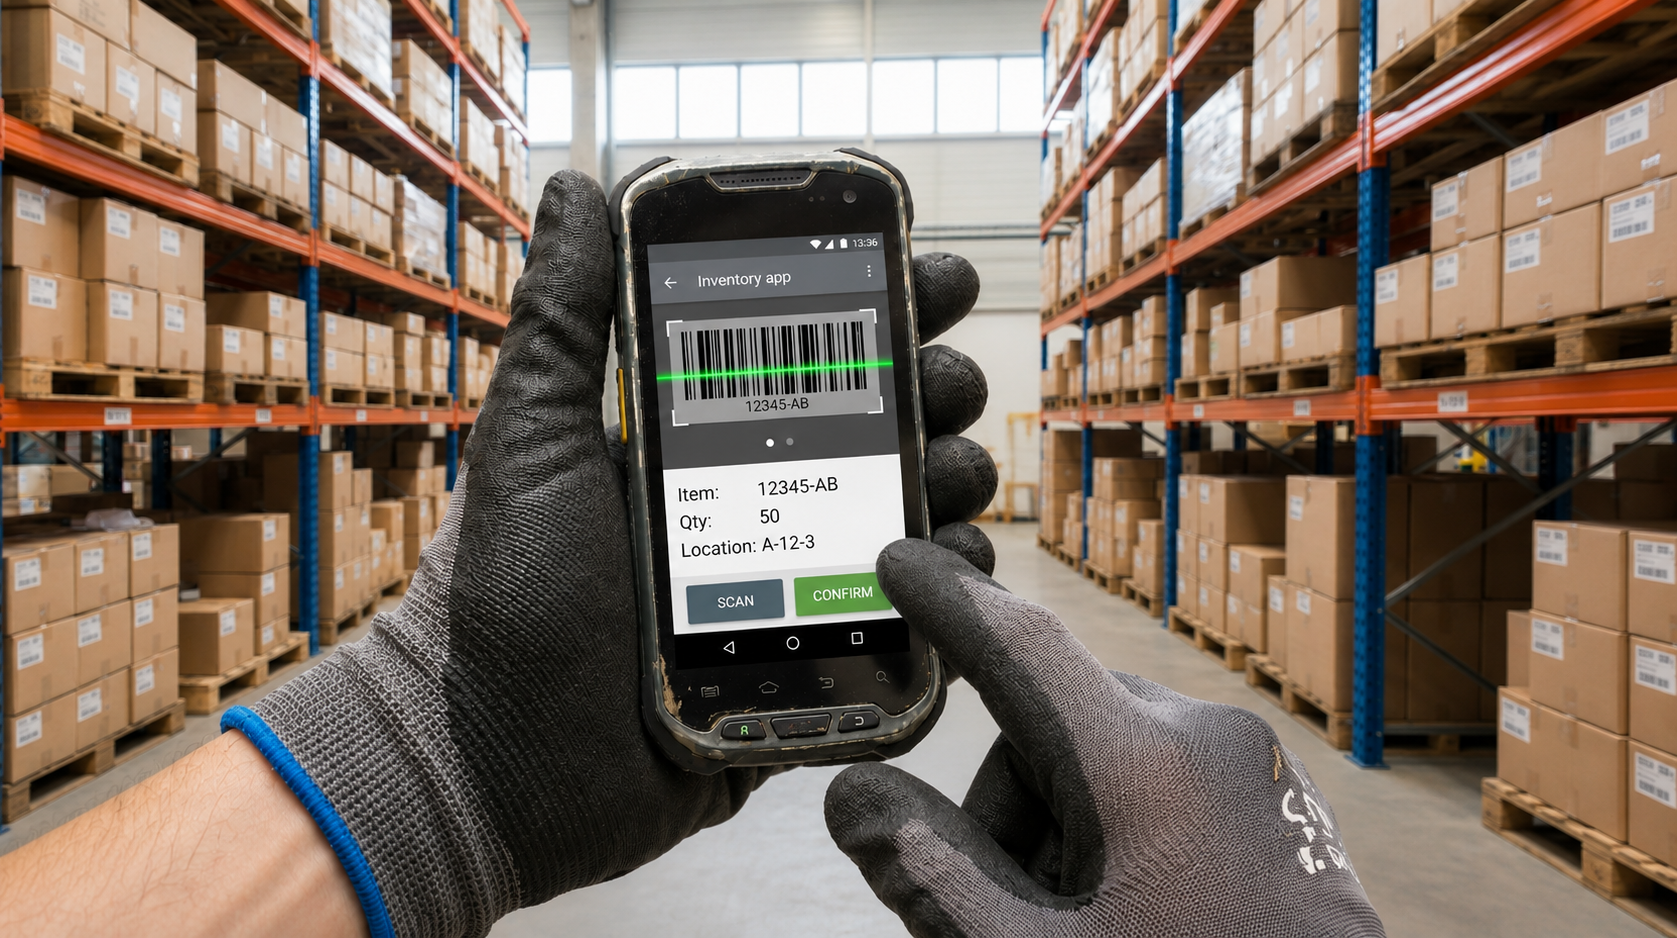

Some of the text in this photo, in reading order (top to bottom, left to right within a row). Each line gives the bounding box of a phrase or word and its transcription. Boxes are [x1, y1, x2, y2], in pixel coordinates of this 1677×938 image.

[852, 238, 878, 248] 13:36
[698, 271, 791, 288] Inventory app
[746, 397, 809, 412] 12345-AB
[678, 476, 839, 502] Item: 12345-AB
[680, 508, 780, 532] Qty: 50
[681, 534, 815, 558] Location: A-12-3
[717, 595, 755, 609] SCAN
[813, 586, 873, 602] CONFIRM
